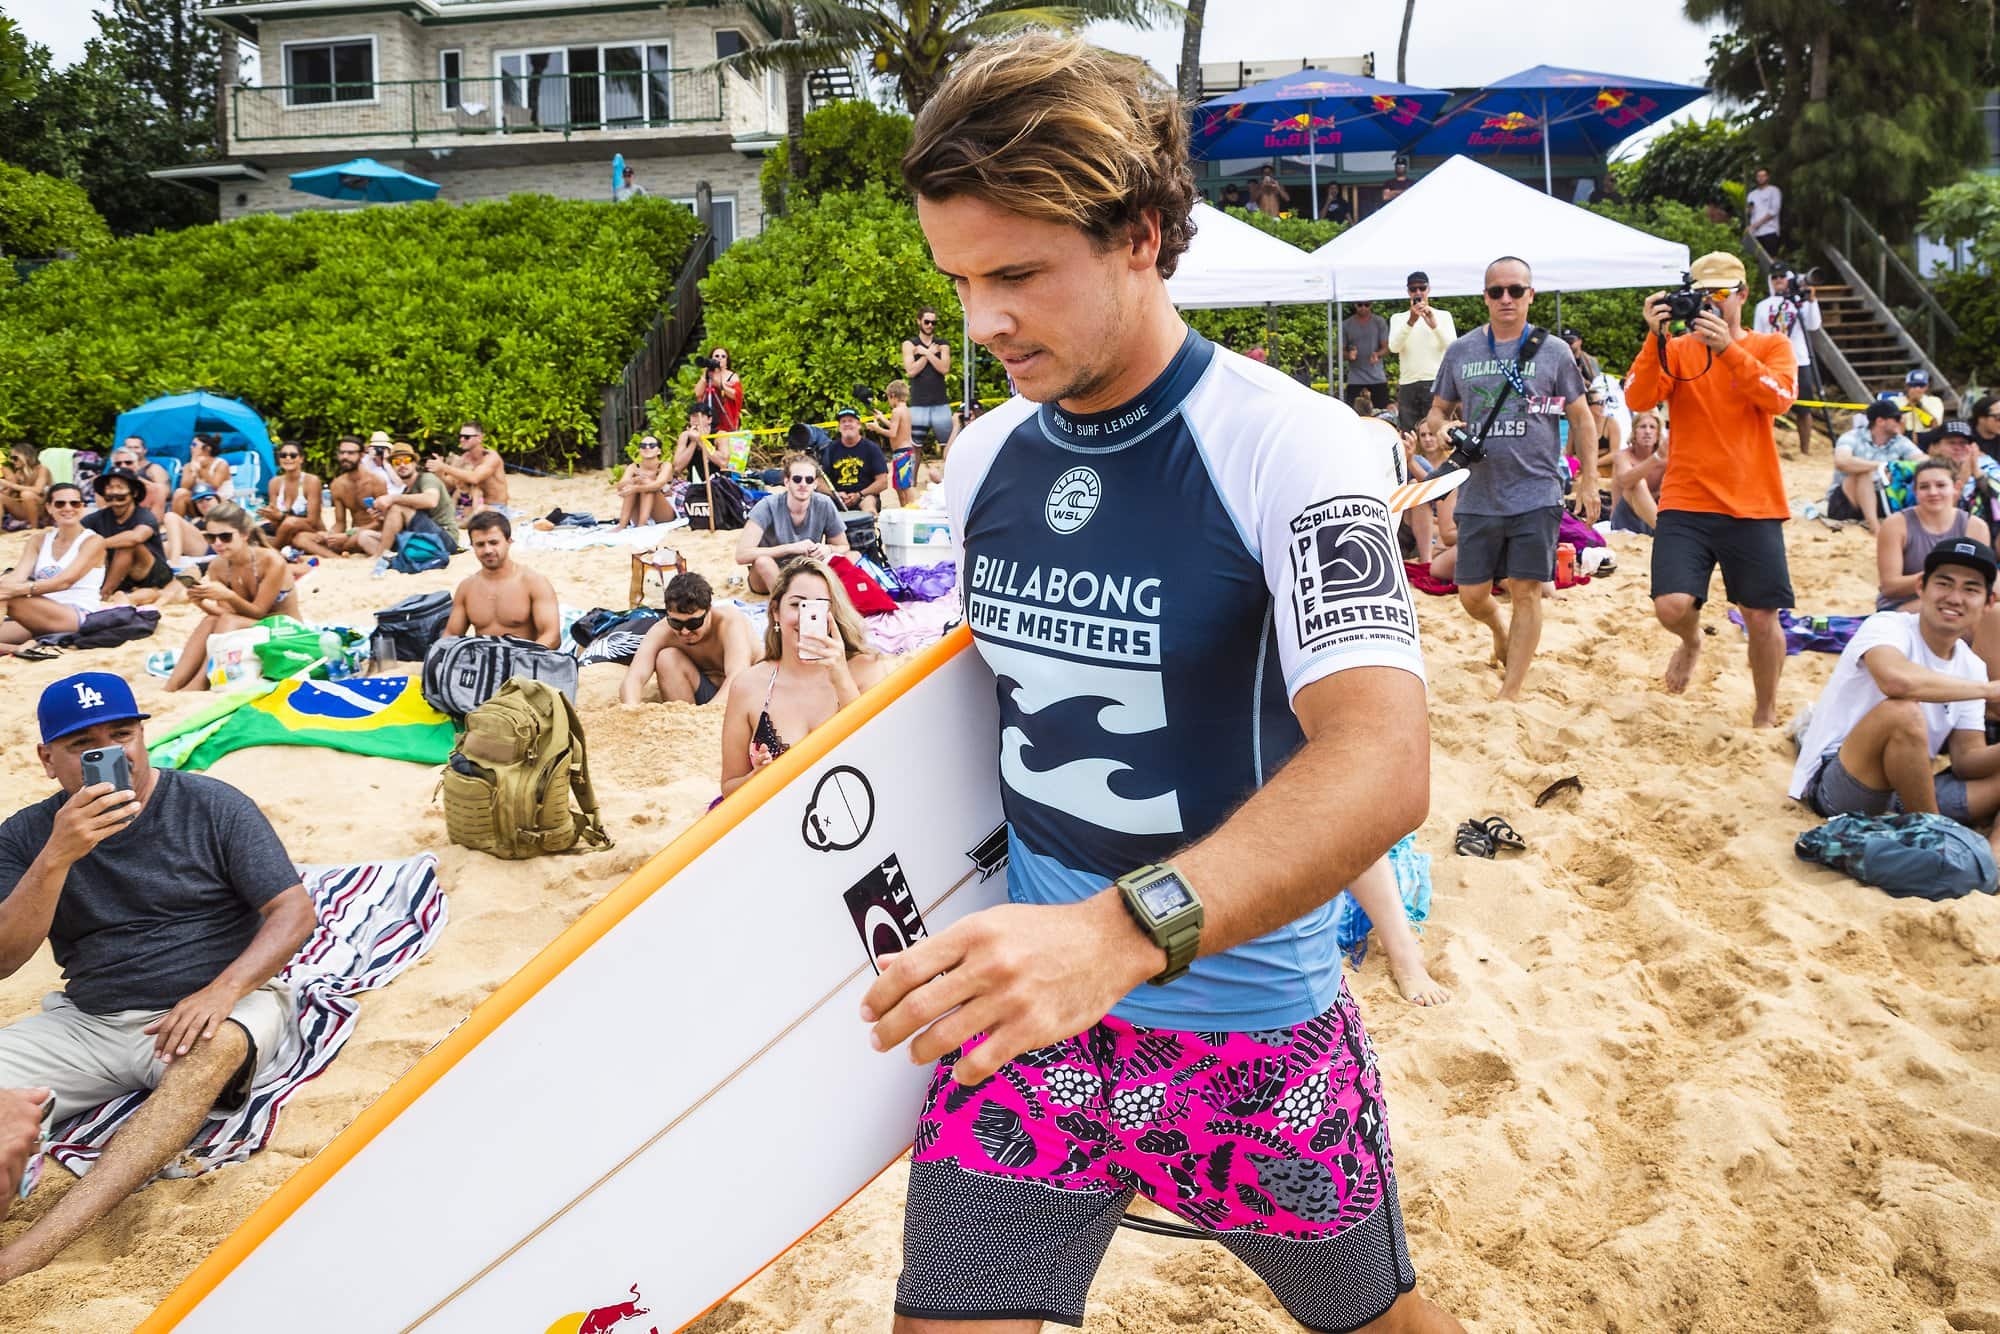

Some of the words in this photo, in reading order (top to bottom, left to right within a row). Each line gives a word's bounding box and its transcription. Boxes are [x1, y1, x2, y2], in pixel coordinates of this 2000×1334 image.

[1053, 411, 1073, 434] WORLD
[1076, 423, 1100, 436] SURF
[1104, 404, 1149, 434] LEAGUE
[1053, 509, 1083, 521] WSL
[1312, 504, 1386, 527] BILLABONG
[971, 554, 1162, 617] BILLABONG
[1298, 535, 1316, 616] PIPE
[970, 600, 1011, 632] PIPE
[1016, 610, 1151, 656] MASTERS
[1304, 604, 1409, 636] MASTERS
[1311, 638, 1337, 654] NORTH
[1369, 633, 1396, 641] HAWAII
[73, 682, 105, 709] LA
[881, 863, 927, 942] KLEY
